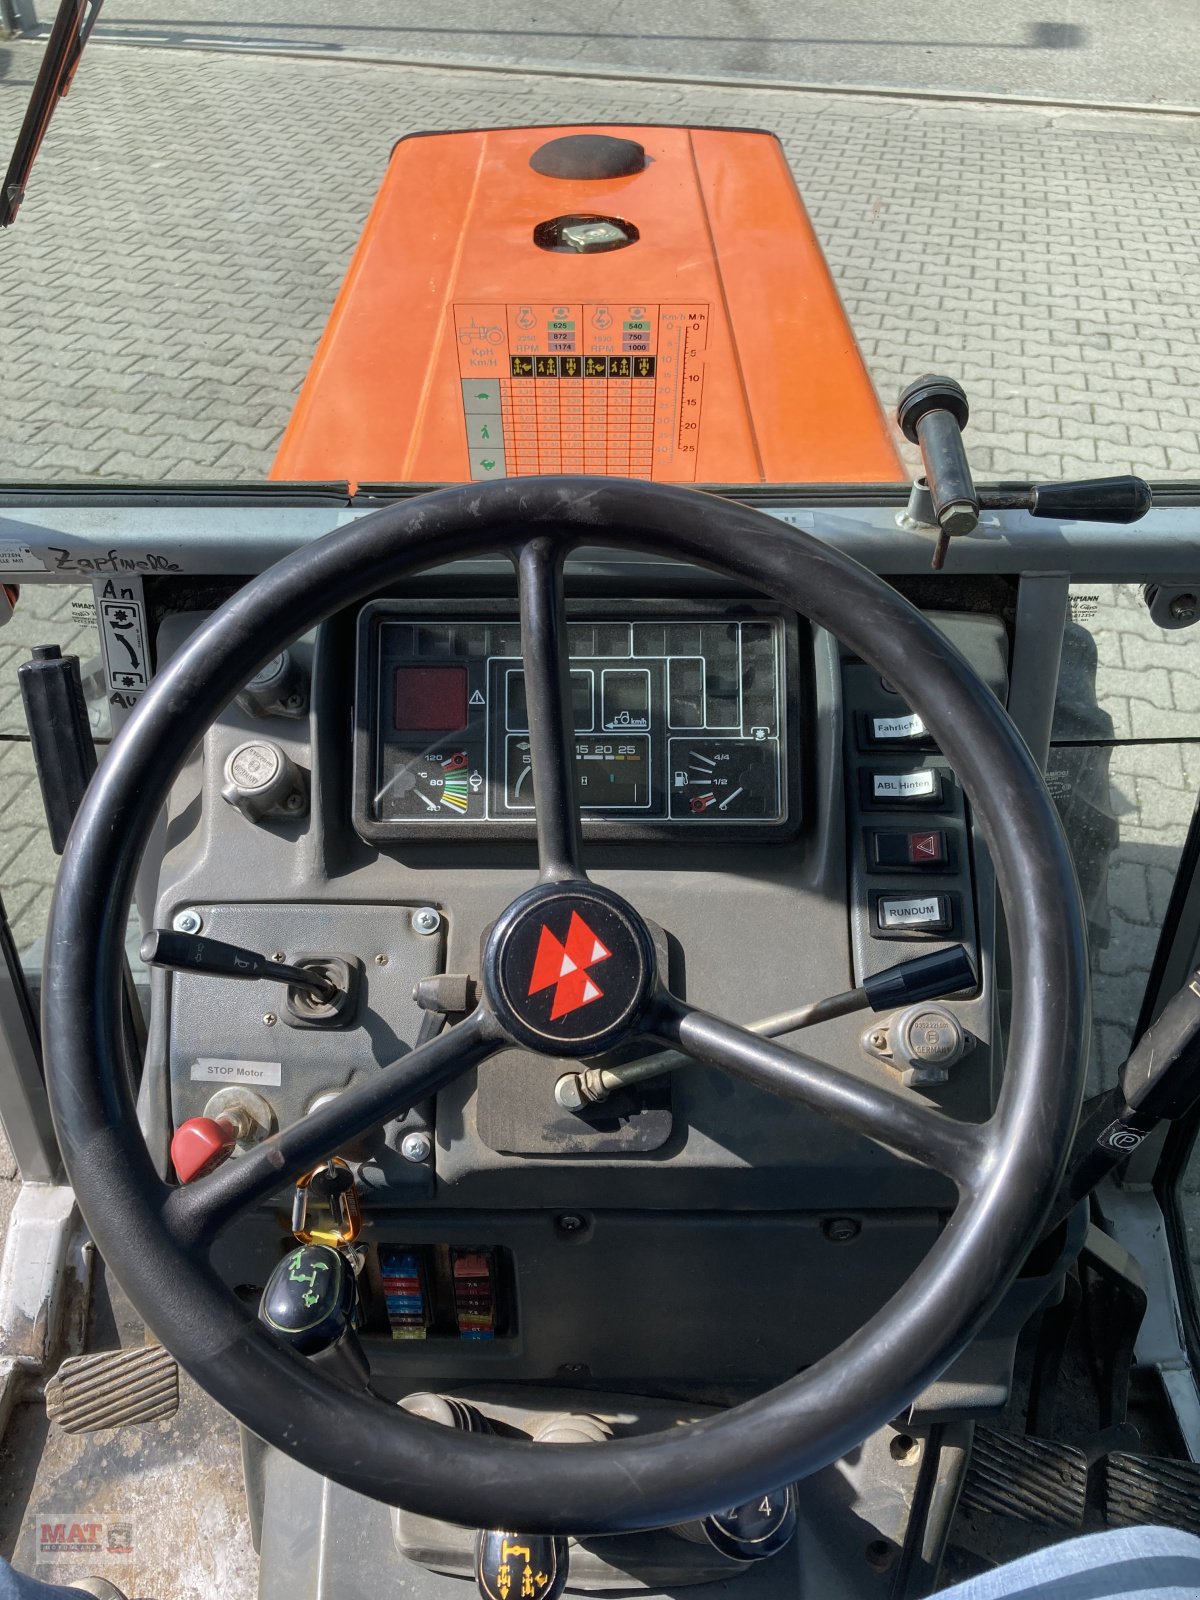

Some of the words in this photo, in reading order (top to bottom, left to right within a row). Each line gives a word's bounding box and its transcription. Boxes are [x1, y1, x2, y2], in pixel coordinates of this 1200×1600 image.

[470, 358, 497, 367] Km/H
[103, 579, 133, 600] An
[878, 721, 918, 732] Fahrlicht
[900, 781, 929, 789] Hinten
[889, 905, 934, 917] RUNDUM
[207, 1066, 234, 1074] STOP
[237, 1068, 264, 1077] Motor
[759, 1496, 772, 1516] 4
